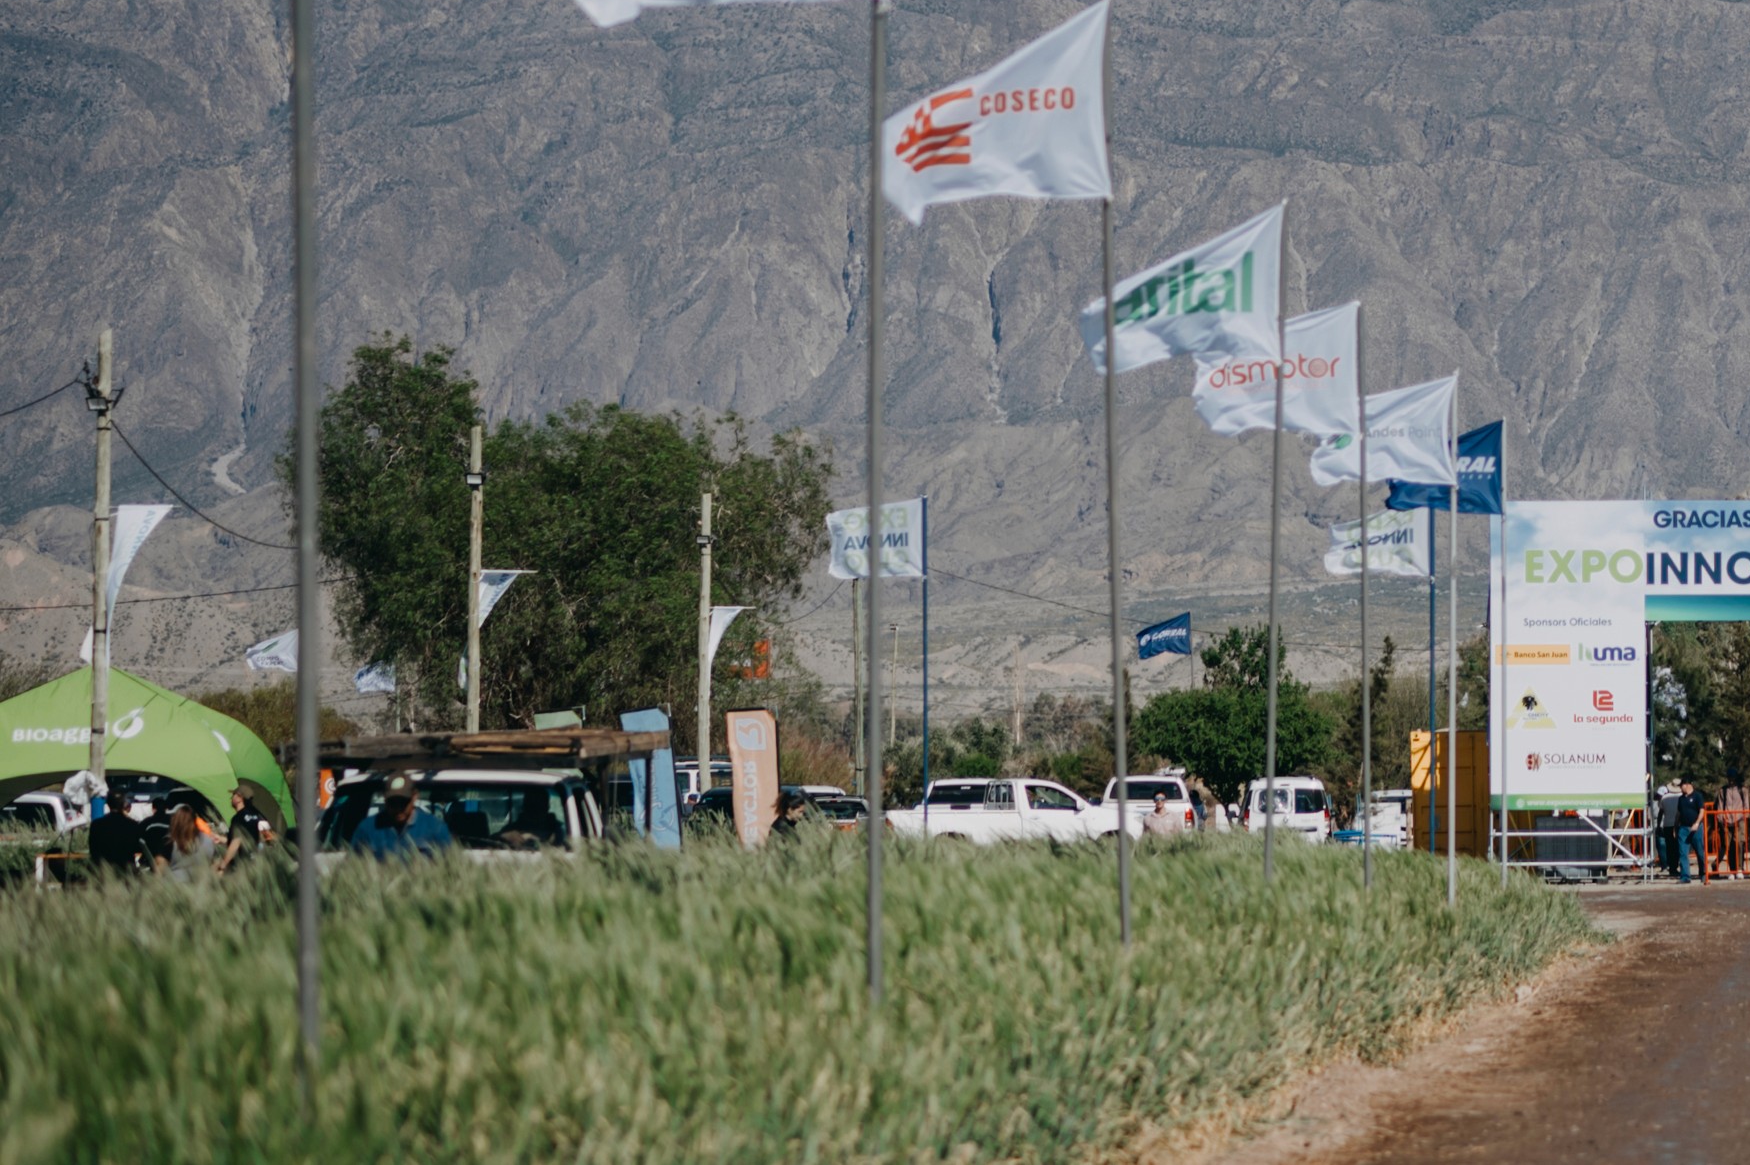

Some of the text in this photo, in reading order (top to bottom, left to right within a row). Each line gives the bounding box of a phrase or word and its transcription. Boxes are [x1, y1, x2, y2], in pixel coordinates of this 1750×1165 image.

[980, 86, 1074, 116] COSECO
[1209, 354, 1340, 388] dismotor
[1523, 617, 1612, 628] Sponsors Oficiales
[1514, 651, 1568, 659] Banco San Juan
[1573, 714, 1633, 726] la segunda
[1544, 753, 1607, 764] SOLANUM
